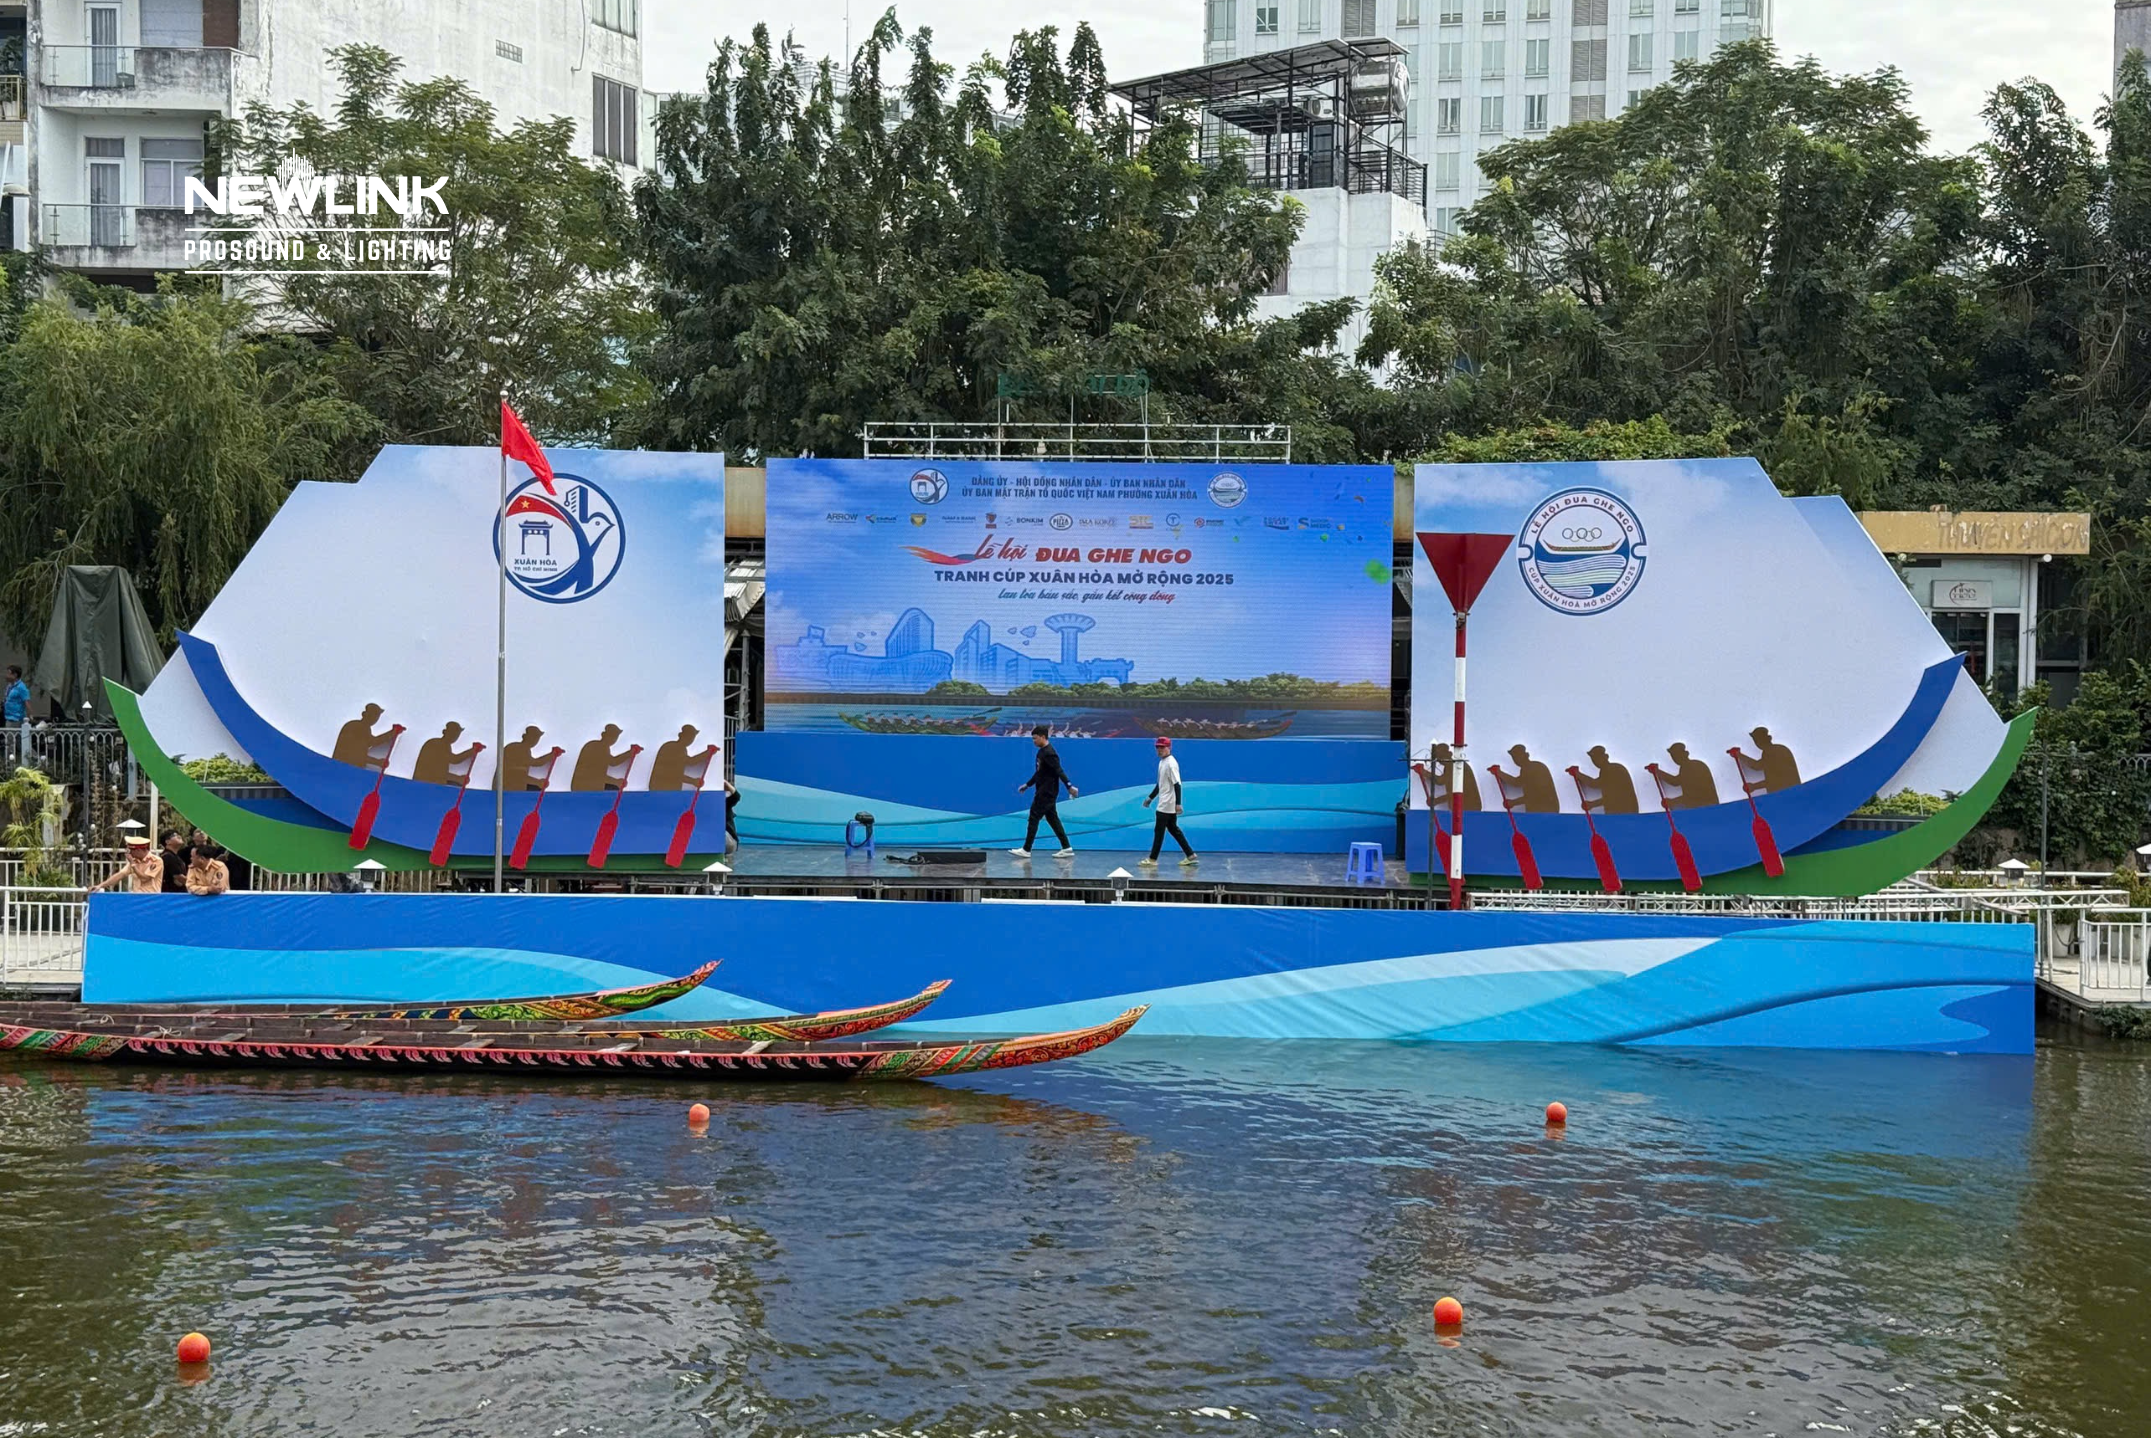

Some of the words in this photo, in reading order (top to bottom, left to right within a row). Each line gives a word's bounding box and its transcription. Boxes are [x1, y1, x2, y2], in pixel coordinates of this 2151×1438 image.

[1124, 479, 1140, 488] BAN
[975, 488, 993, 498] BAN
[1096, 489, 1115, 499] NAM
[826, 513, 858, 522] ARROW
[1541, 503, 1560, 519] HỘI
[1564, 496, 1588, 506] ĐUA
[1593, 498, 1615, 511] GHE
[1616, 512, 1633, 533] NGO
[998, 537, 1028, 561] hội
[1035, 547, 1080, 562] ĐUA
[1087, 548, 1135, 563] GHE
[1138, 548, 1192, 564] NGO
[934, 570, 990, 582] TRANH
[993, 568, 1025, 582] CÚP
[1028, 569, 1075, 583] XUÂN
[1078, 569, 1114, 584] HÒA
[1117, 569, 1144, 584] MỞ
[1147, 570, 1193, 587] RỘNG
[1196, 573, 1234, 585] 2025
[1529, 567, 1540, 584] CÚP
[1539, 585, 1560, 602] XUÂN
[1599, 587, 1623, 604] RỘNG
[1622, 566, 1636, 586] 2025
